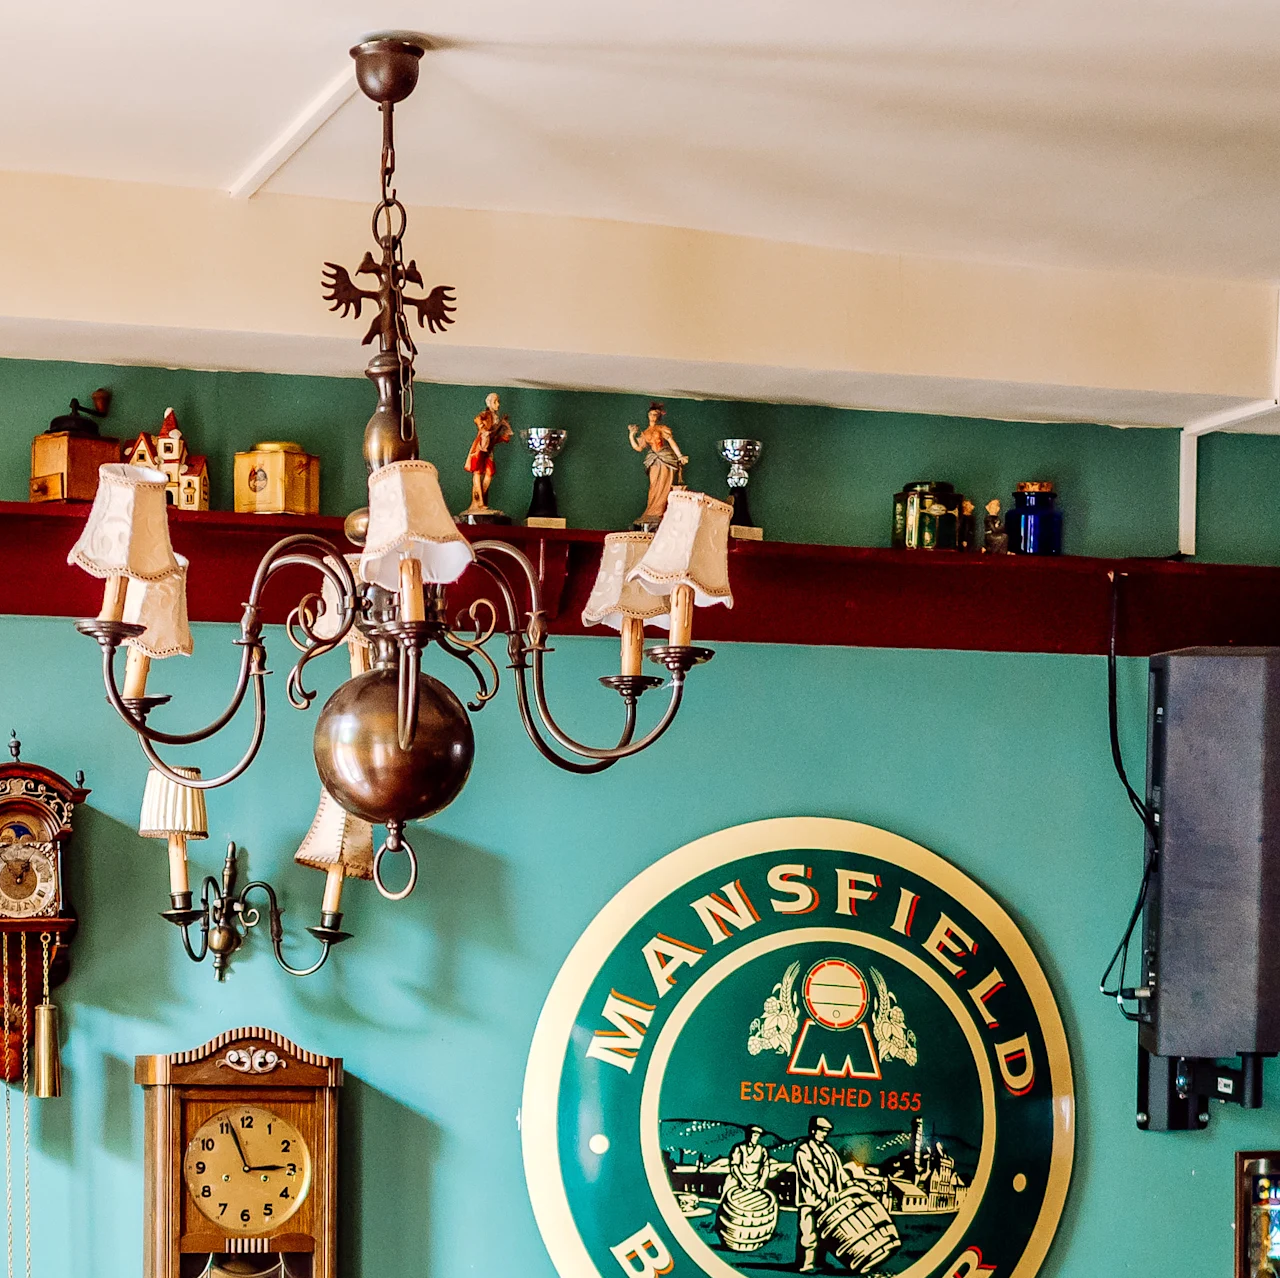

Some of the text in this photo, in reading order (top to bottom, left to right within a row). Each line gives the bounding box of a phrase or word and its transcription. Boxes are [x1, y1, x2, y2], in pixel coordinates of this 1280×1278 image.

[586, 863, 1036, 1096] MANSFIELD
[740, 1080, 922, 1112] ESTABLISHED 1855
[219, 1122, 229, 1134] 11
[240, 1116, 254, 1129] 12
[201, 1138, 214, 1151] 10
[281, 1140, 291, 1152] 2
[196, 1162, 206, 1175] 9
[286, 1163, 296, 1176] 3
[201, 1185, 212, 1198] 8
[279, 1187, 290, 1199] 4
[218, 1203, 228, 1216] 7
[240, 1209, 250, 1222] 6
[263, 1204, 273, 1216] 5
